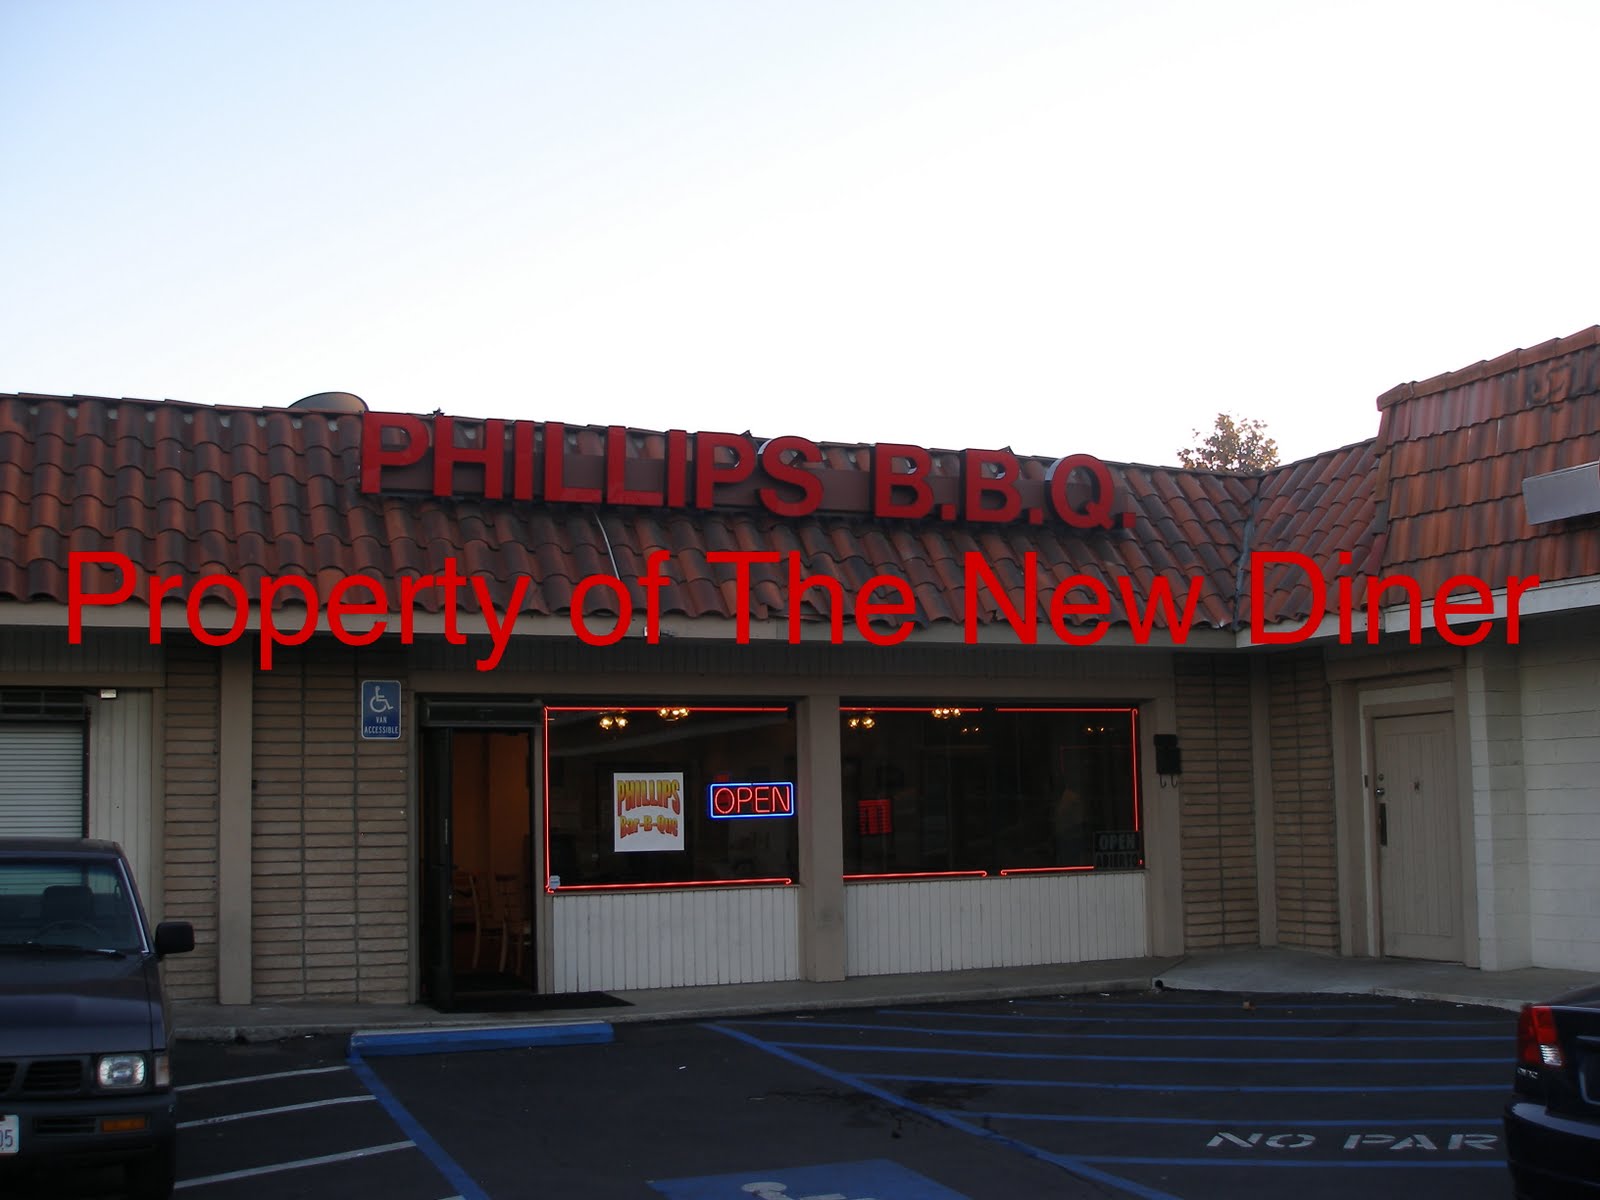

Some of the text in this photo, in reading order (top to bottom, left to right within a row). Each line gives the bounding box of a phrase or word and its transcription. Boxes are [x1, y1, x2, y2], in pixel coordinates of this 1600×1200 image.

[361, 411, 1137, 530] PHILLIPS B.B.Q.
[376, 716, 387, 724] VAN
[364, 726, 399, 734] ACCESSIBLE
[616, 779, 681, 817] PHILLIPS
[714, 786, 791, 814] OPEN
[1099, 833, 1136, 850] OPEN
[1206, 1132, 1499, 1151] NO PAR
